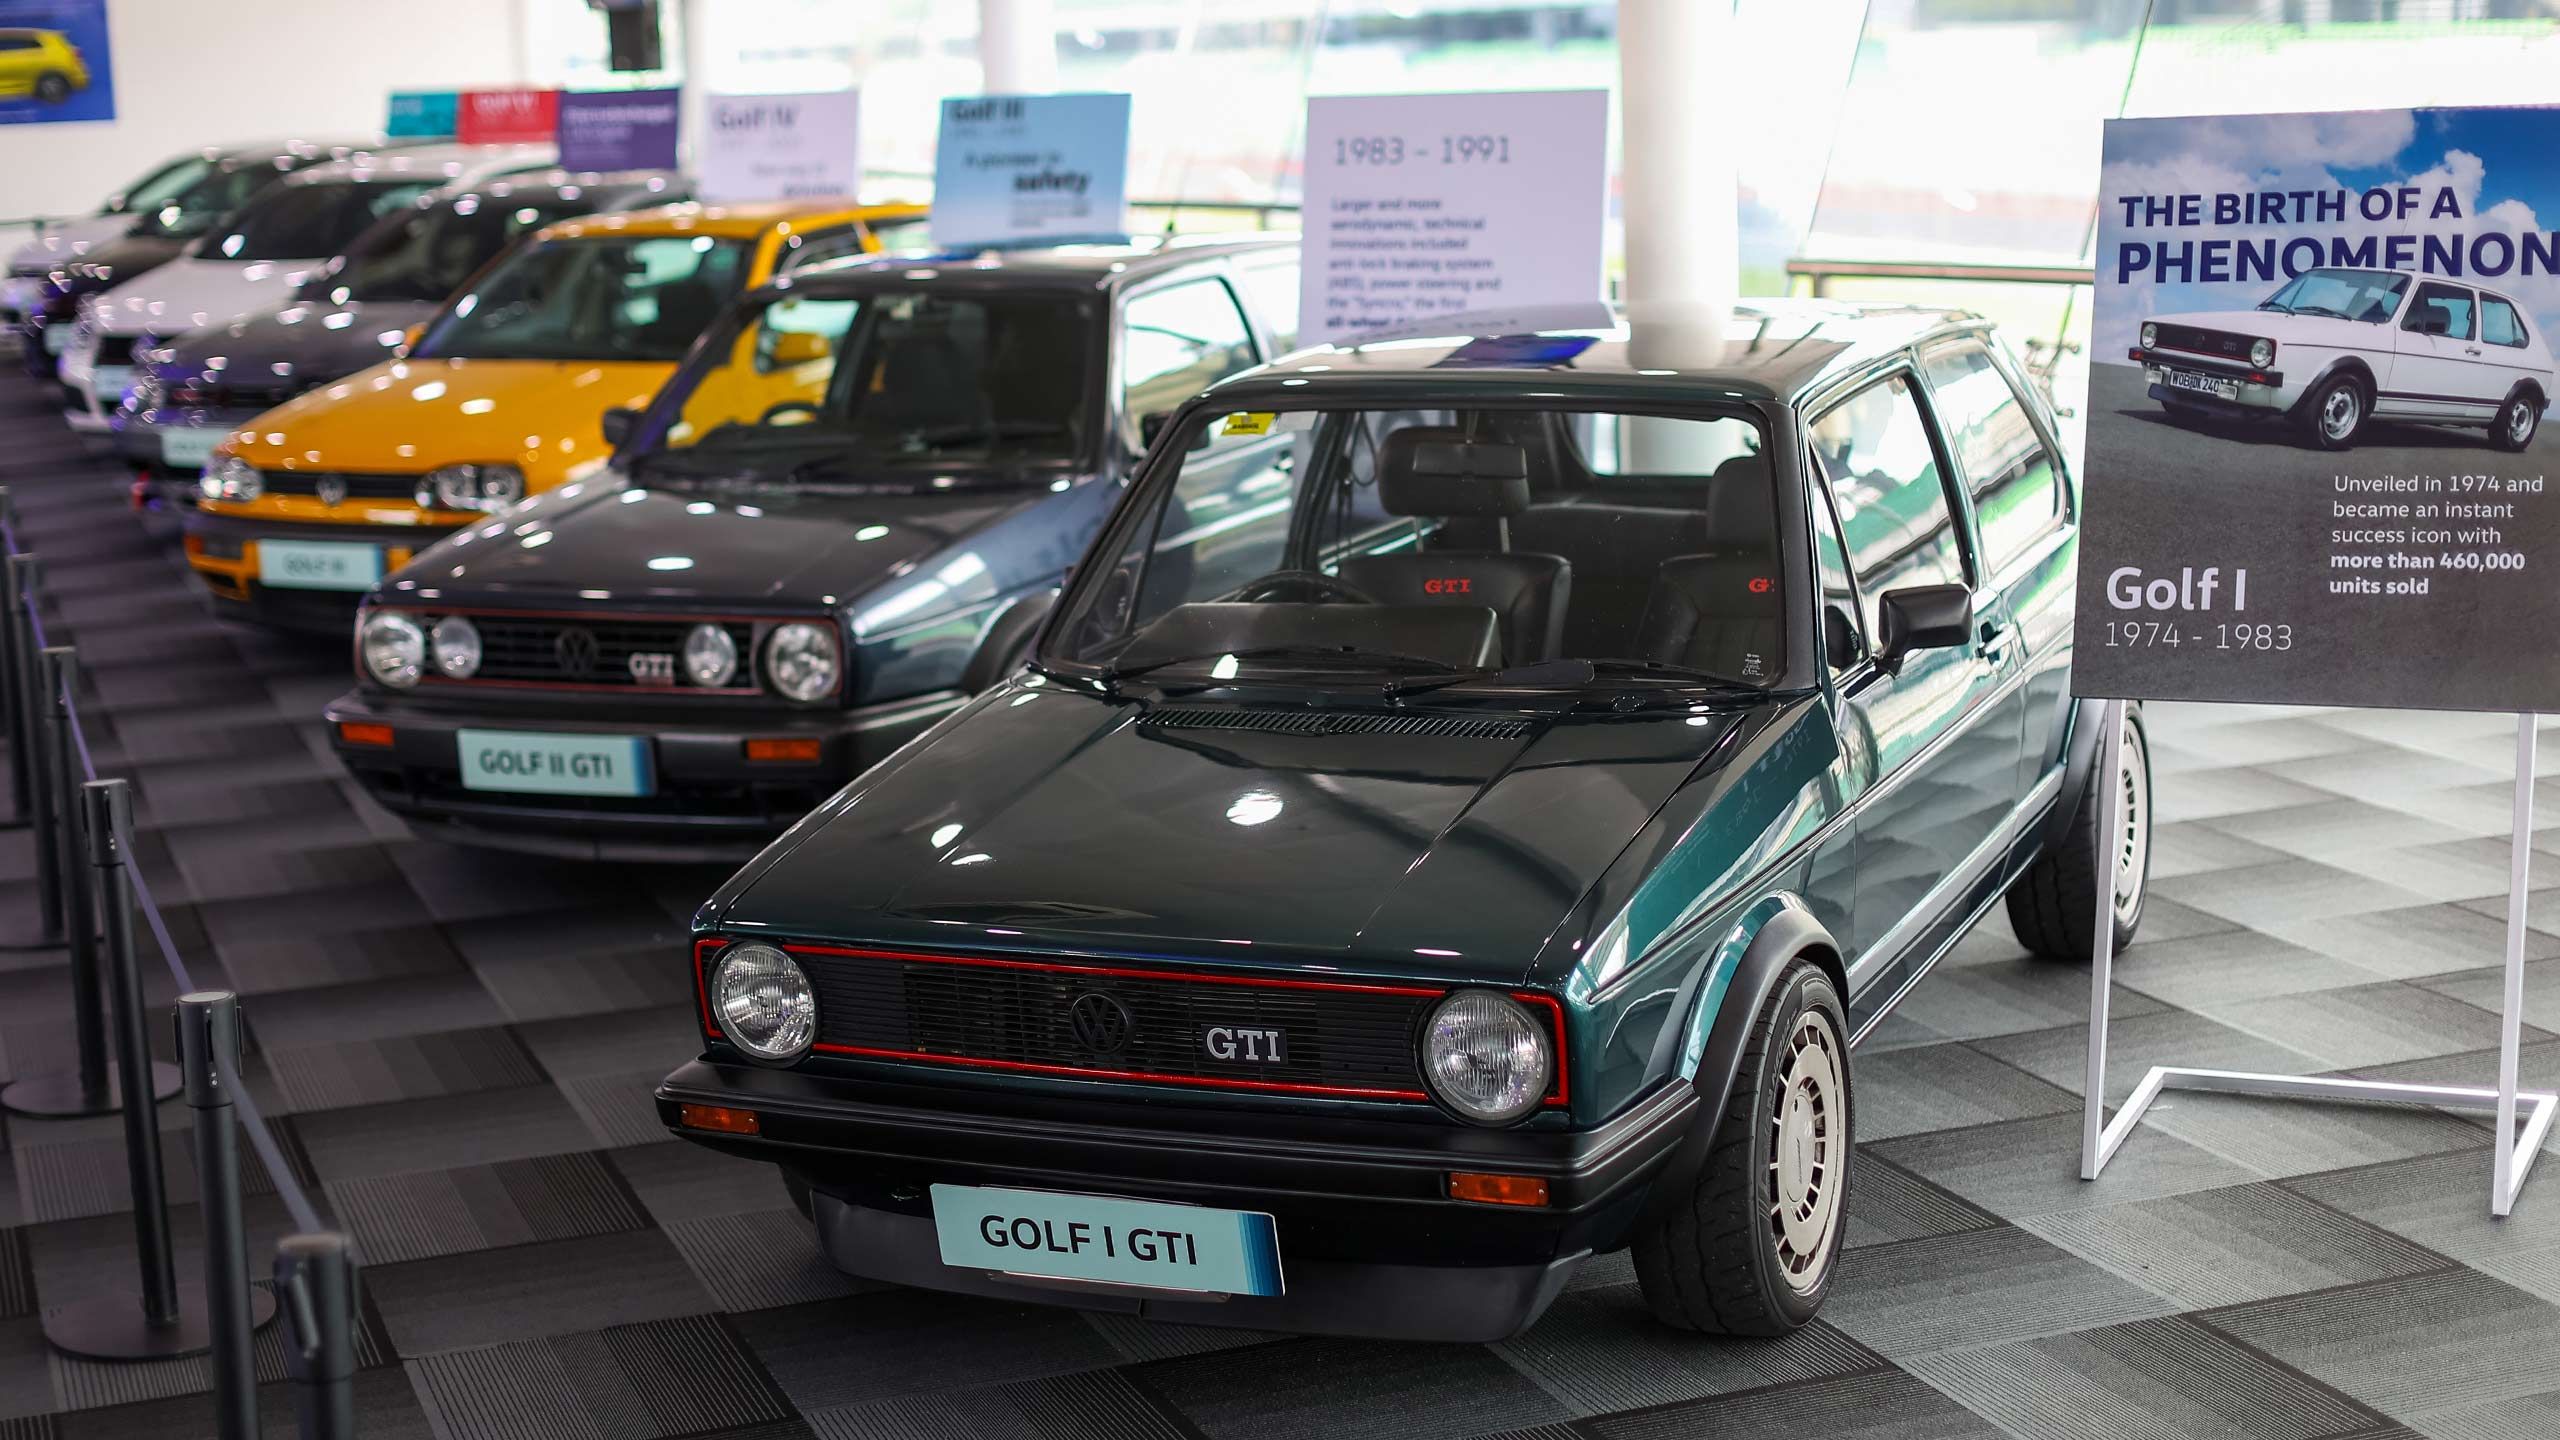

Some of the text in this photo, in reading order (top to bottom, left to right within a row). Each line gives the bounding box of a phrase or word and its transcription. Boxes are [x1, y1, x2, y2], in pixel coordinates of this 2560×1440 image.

[713, 103, 767, 131] Golf
[949, 98, 997, 121] Golf
[1334, 138, 1404, 166] 1983
[1441, 136, 1511, 165] 1991
[1012, 170, 1089, 194] safety
[1331, 199, 1442, 214] Larger and more
[2118, 185, 2463, 228] THE BIRTH OF A
[1425, 218, 1485, 229] technical
[2118, 231, 2560, 284] PHENOMENON
[1476, 278, 1501, 290] and
[2202, 378, 2219, 392] 240
[2334, 475, 2543, 492] Unveiled in 1974 and
[2333, 501, 2514, 517] became an instant
[2332, 527, 2501, 543] success icon with
[2330, 552, 2526, 573] more than 460,000
[1424, 579, 1472, 593] GTI
[2107, 566, 2247, 611] Golf I
[2329, 577, 2429, 595] units sold
[2105, 621, 2181, 648] 1974
[2216, 623, 2292, 651] 1983
[629, 653, 675, 677] GTI
[480, 748, 613, 779] GOLF II GTI
[1206, 1027, 1281, 1063] GTI
[979, 1214, 1198, 1266] GOLF I GTI
